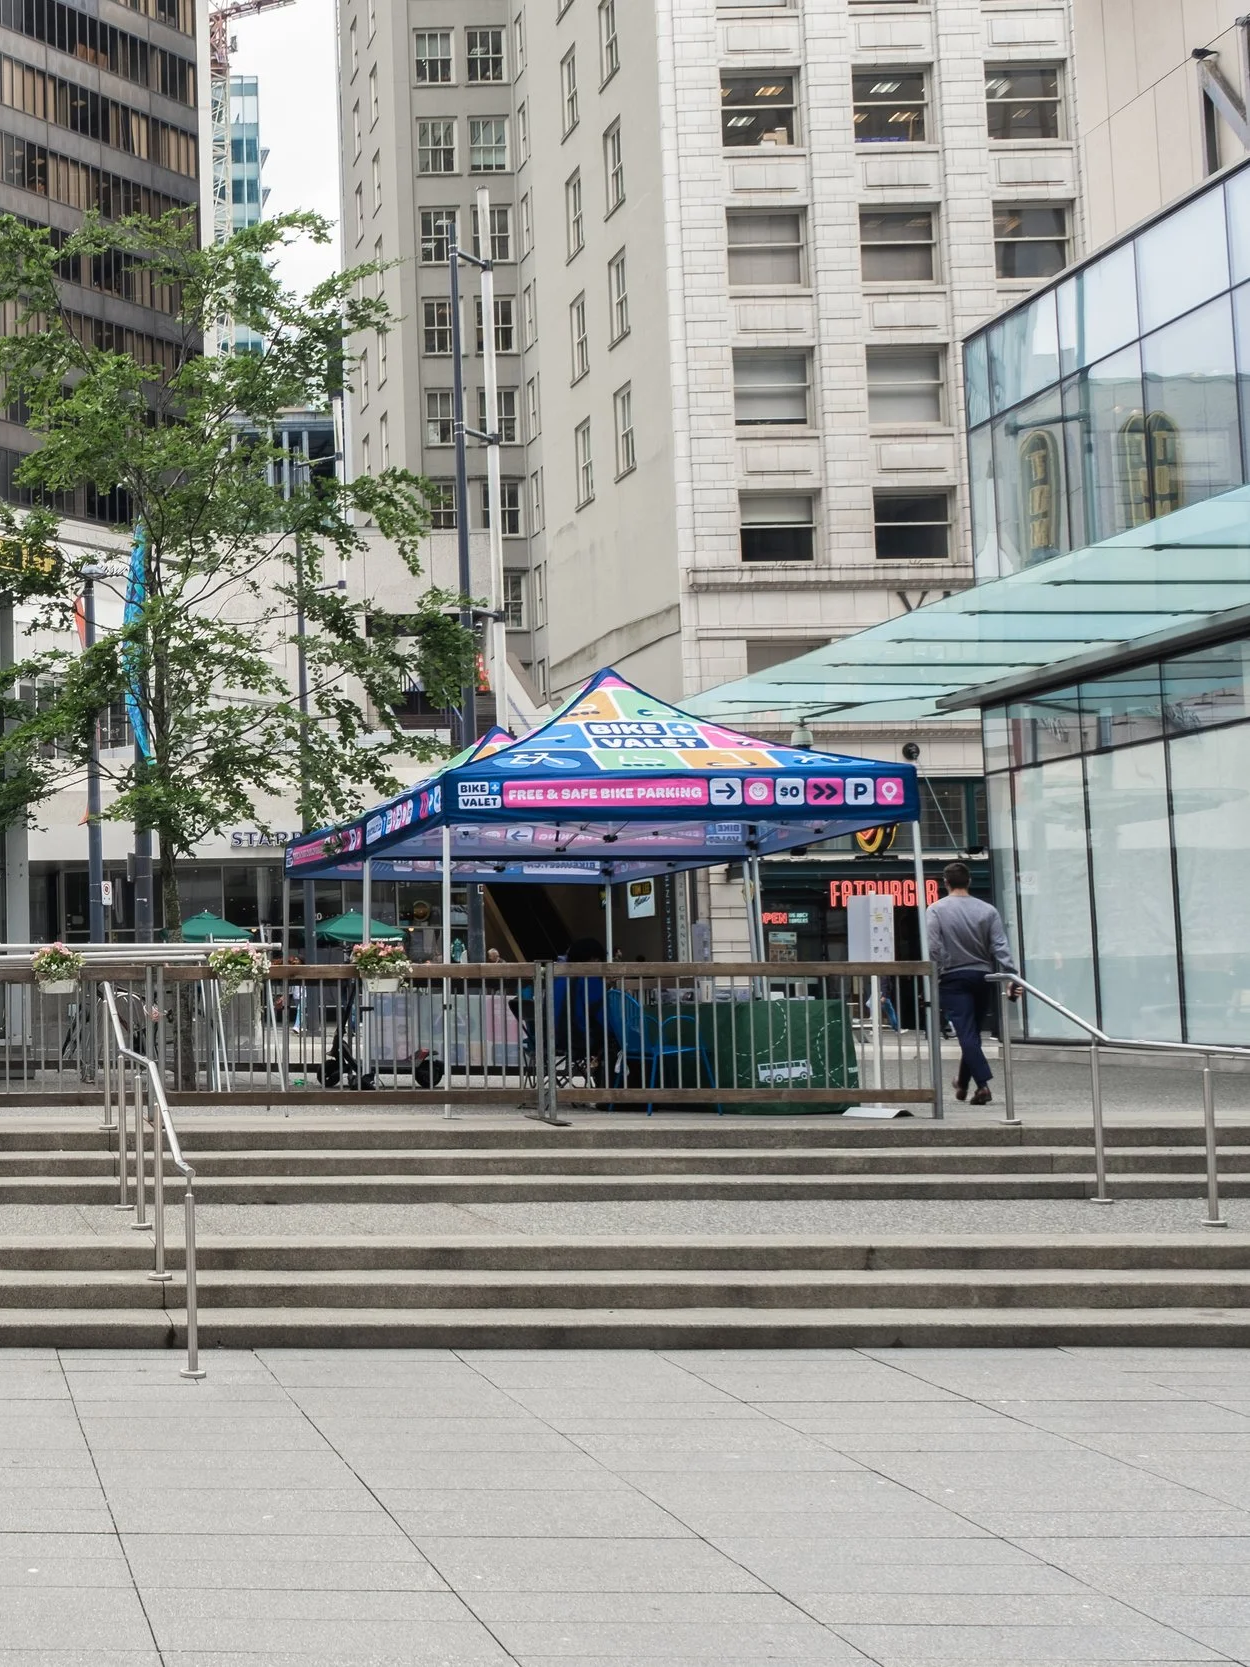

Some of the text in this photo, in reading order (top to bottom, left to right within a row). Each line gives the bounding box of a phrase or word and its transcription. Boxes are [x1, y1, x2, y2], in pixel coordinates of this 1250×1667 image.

[591, 723, 662, 735] BIKE
[600, 738, 697, 749] VALET
[460, 784, 487, 793] BIKE
[508, 786, 703, 800] FREE & SAFE BIKE PARKING
[854, 783, 867, 800] P
[461, 797, 498, 807] VALET
[830, 880, 939, 907] FATBURGR
[762, 912, 788, 924] PEN
